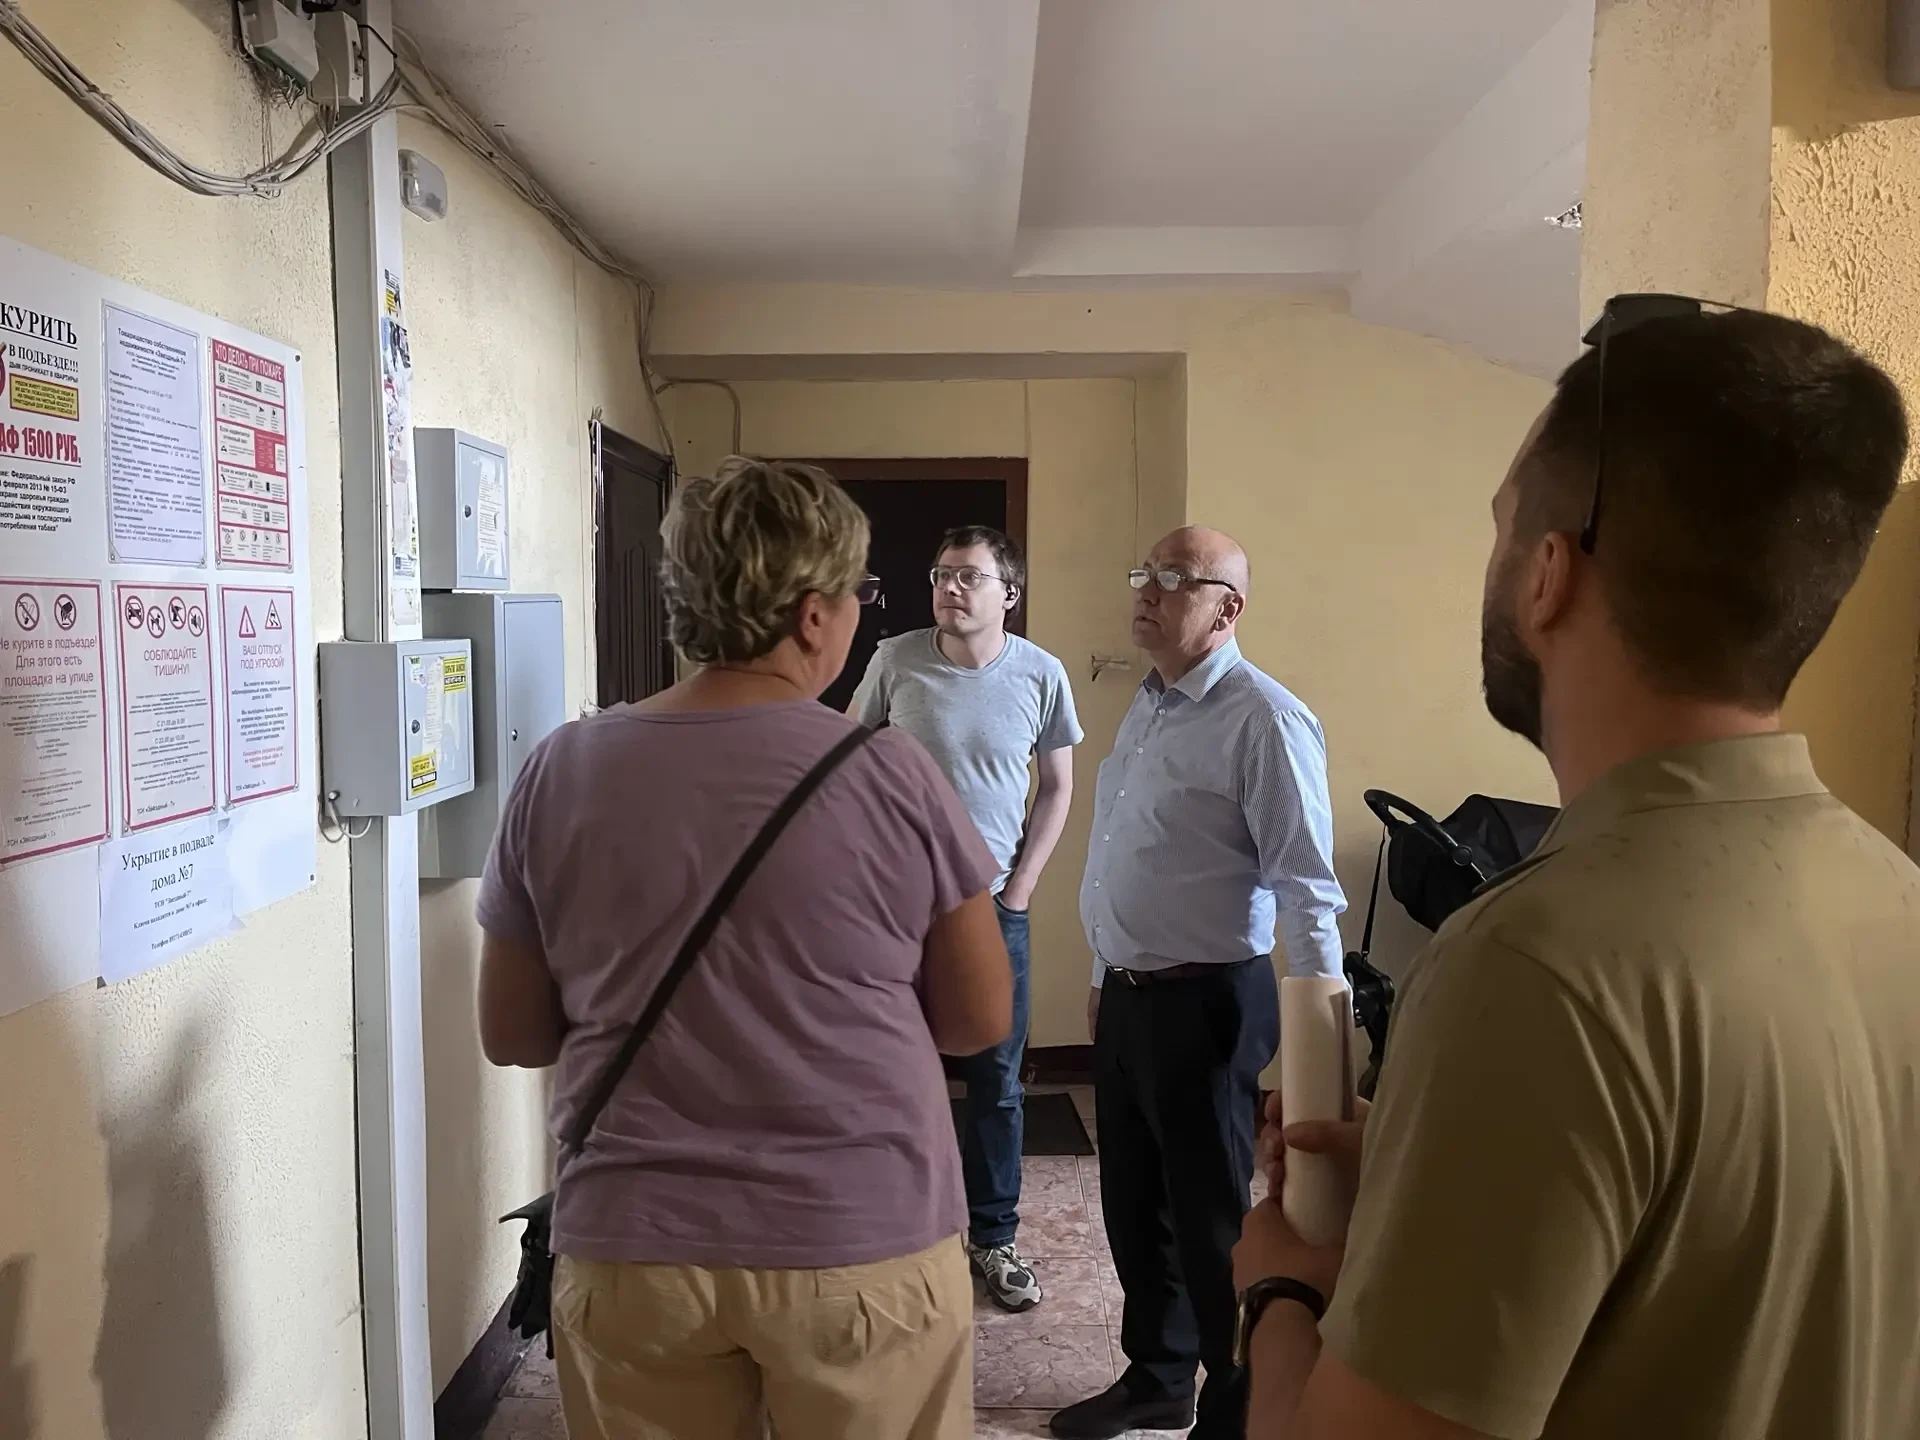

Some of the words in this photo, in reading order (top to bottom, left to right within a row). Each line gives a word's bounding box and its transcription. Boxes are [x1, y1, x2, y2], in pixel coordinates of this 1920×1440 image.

[0, 302, 77, 345] КУРИТЬ
[9, 344, 16, 357] В
[18, 346, 78, 373] ПОДЪЕЗДЕ!!!
[215, 342, 227, 361] ЧТО
[227, 347, 248, 371] ДЕЛАТЬ
[248, 355, 260, 374] ПРИ
[260, 359, 282, 381] ПОЖАРЕ
[22, 364, 49, 376] ПРОНИКАЕТ
[50, 370, 54, 378] В
[22, 426, 53, 459] 1500
[56, 432, 81, 463] РУБ.
[11, 470, 50, 482] Федеральный
[68, 477, 75, 485] РФ
[3, 480, 28, 490] февраля
[30, 482, 42, 491] 2013
[43, 484, 49, 492] №
[51, 485, 66, 494] 15-ФЗ
[20, 493, 46, 501] здоровья
[47, 496, 69, 504] граждан
[32, 504, 69, 513] окружающего
[15, 513, 31, 521] дыма
[37, 515, 71, 523] последствий
[877, 593, 886, 609] 4
[12, 639, 44, 653] курите
[47, 639, 52, 649] в
[55, 635, 97, 650] подъезде!
[243, 644, 257, 655] ВАШ
[258, 644, 282, 655] ОТПУСК
[144, 647, 197, 661] СОБЛЮДАЙТЕ
[16, 655, 35, 670] Для
[38, 656, 61, 667] этого
[64, 655, 82, 666] есть
[154, 664, 190, 676] ТИШИНУ!
[240, 659, 254, 670] ПОД
[4, 675, 53, 687] площадка
[55, 673, 67, 684] на
[69, 672, 93, 685] улице
[122, 847, 170, 871] Укрытие
[172, 845, 178, 857] в
[180, 834, 215, 855] подвале
[150, 873, 176, 893] дома
[178, 863, 194, 882] №7
